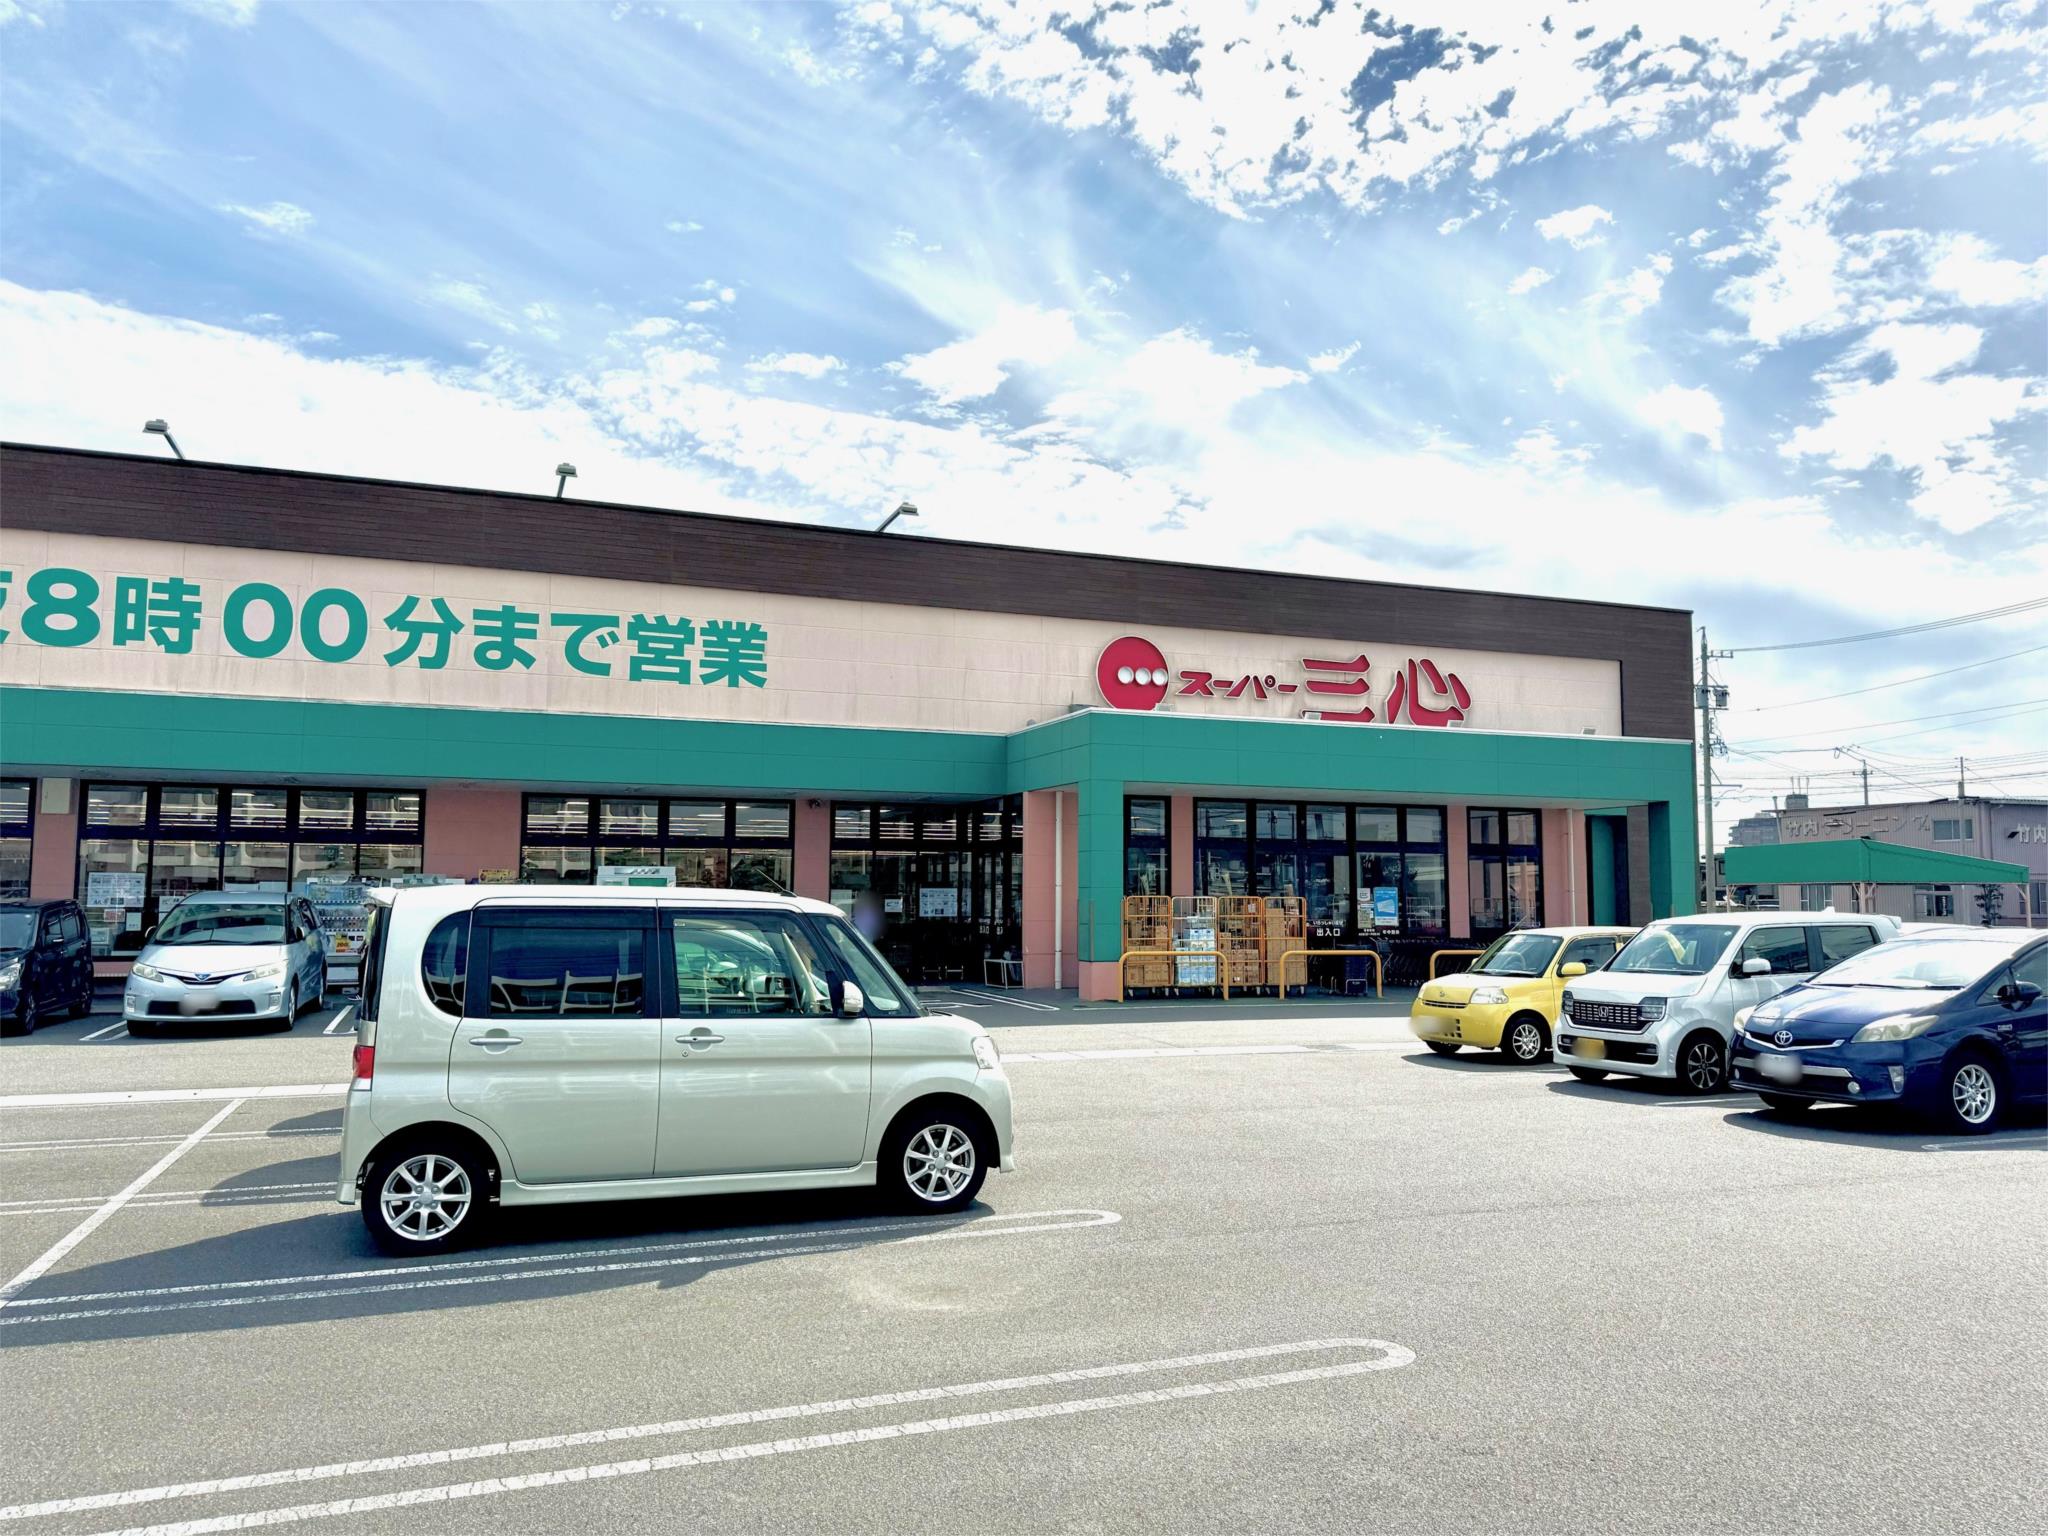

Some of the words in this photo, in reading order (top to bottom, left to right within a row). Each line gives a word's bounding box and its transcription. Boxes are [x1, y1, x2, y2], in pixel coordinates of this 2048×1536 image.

[0, 567, 768, 688] 8時00分まで営業
[1316, 928, 1341, 937] 出入口
